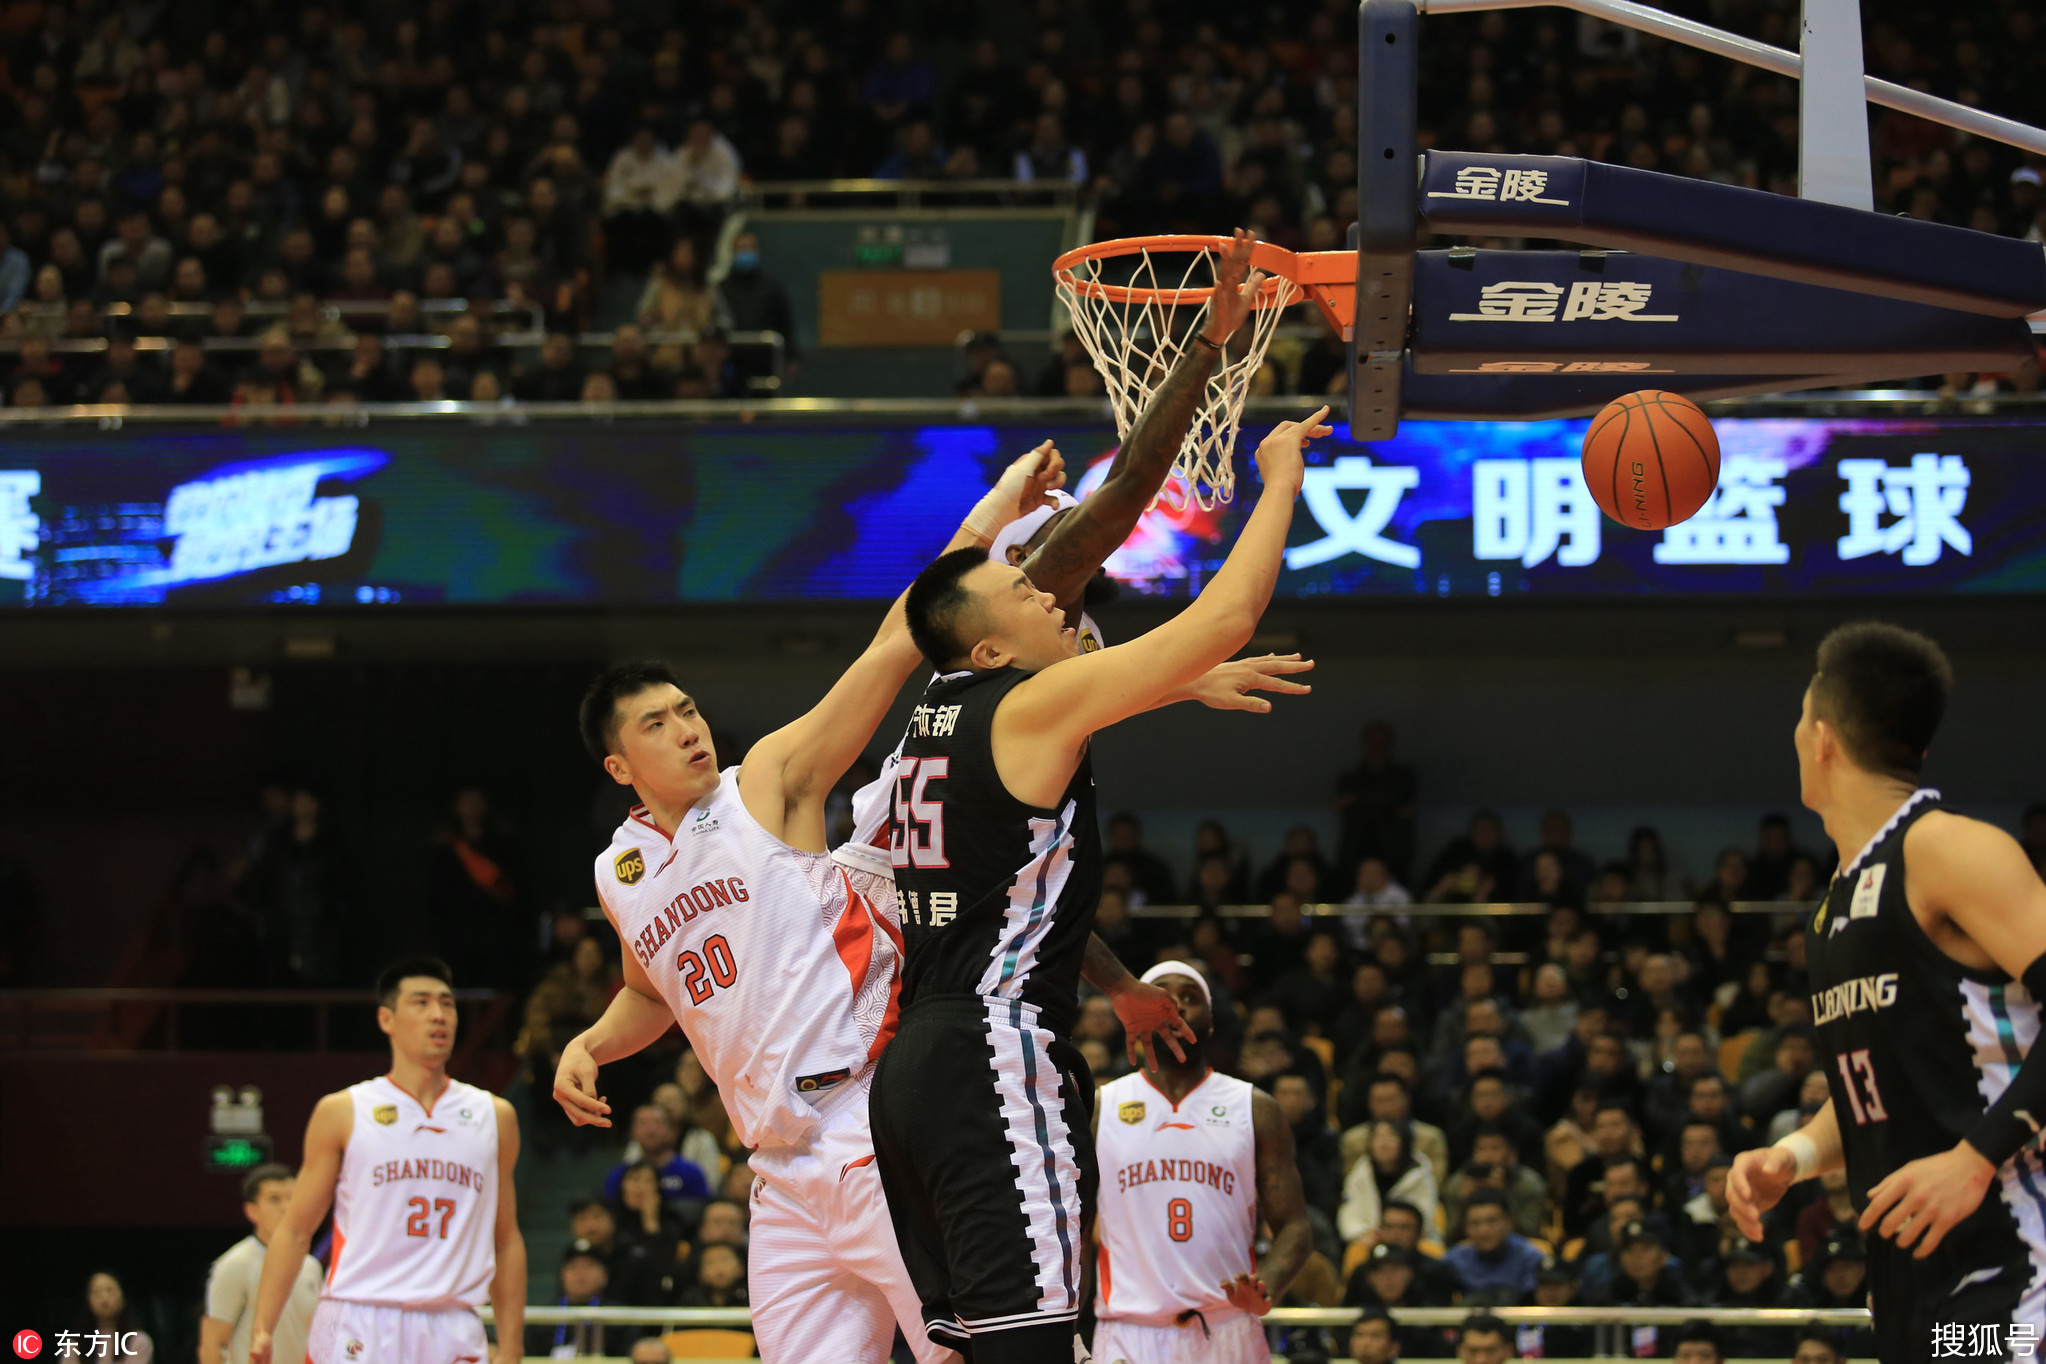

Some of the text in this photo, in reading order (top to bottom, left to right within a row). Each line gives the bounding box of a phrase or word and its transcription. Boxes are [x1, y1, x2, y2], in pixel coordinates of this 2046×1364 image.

[1428, 166, 1570, 206] 金陵
[1449, 281, 1679, 322] 金陵
[891, 757, 950, 868] 55
[616, 858, 644, 881] ups
[634, 877, 750, 968] SHANDONG
[677, 934, 738, 1007] 20
[1837, 1049, 1889, 1125] 13
[373, 1158, 485, 1194] SHANDONG
[1118, 1159, 1235, 1196] SHANDONG
[407, 1196, 456, 1240] 27
[1168, 1198, 1193, 1242] 8
